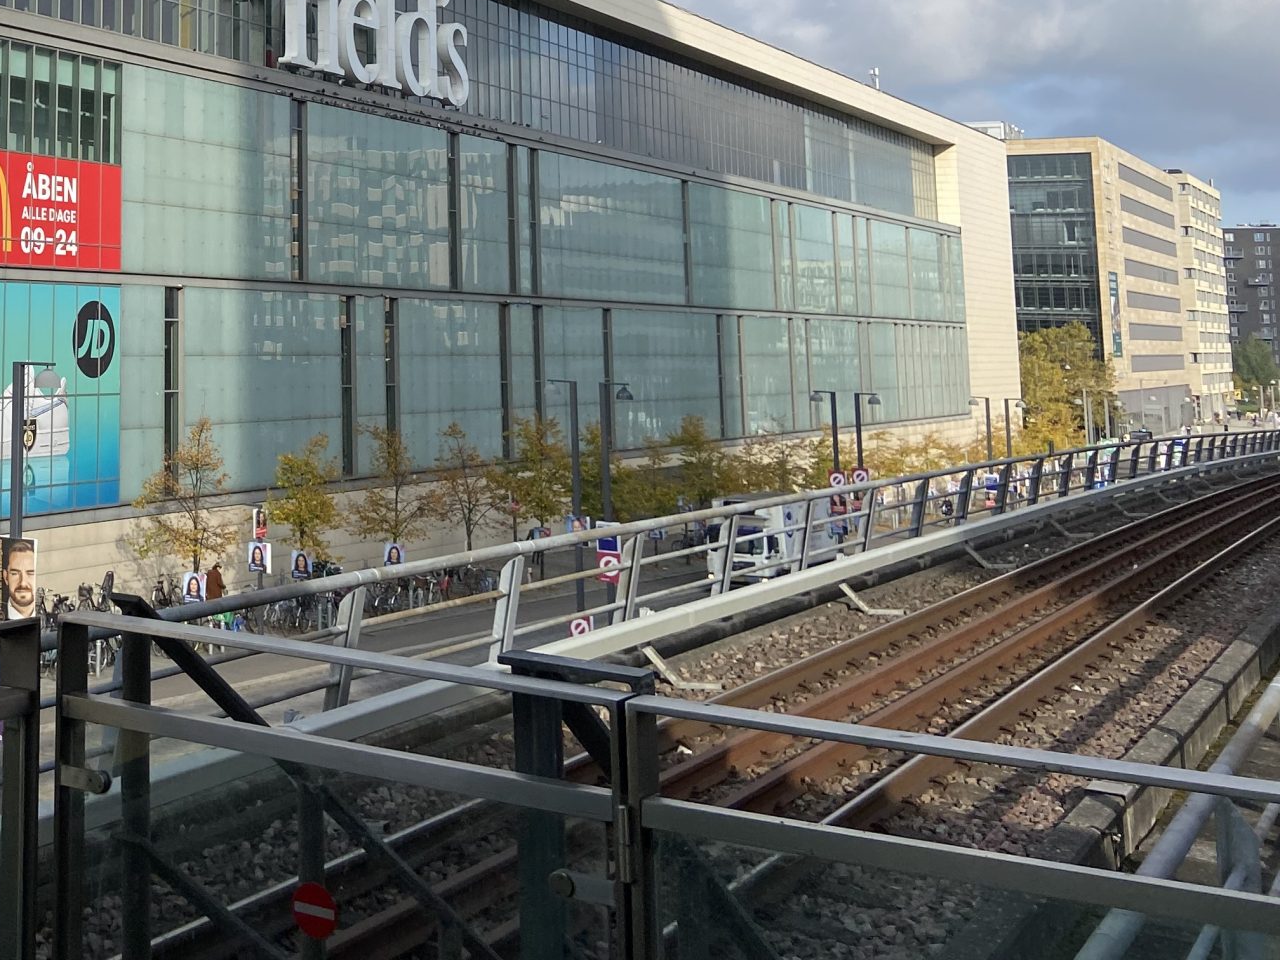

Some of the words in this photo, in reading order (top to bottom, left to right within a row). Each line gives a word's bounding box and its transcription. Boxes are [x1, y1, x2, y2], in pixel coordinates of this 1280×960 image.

[21, 162, 77, 203] ÅBEN
[22, 206, 48, 221] ALLE
[48, 209, 77, 224] DAGE
[20, 226, 78, 257] 09-24
[77, 319, 111, 359] JD
